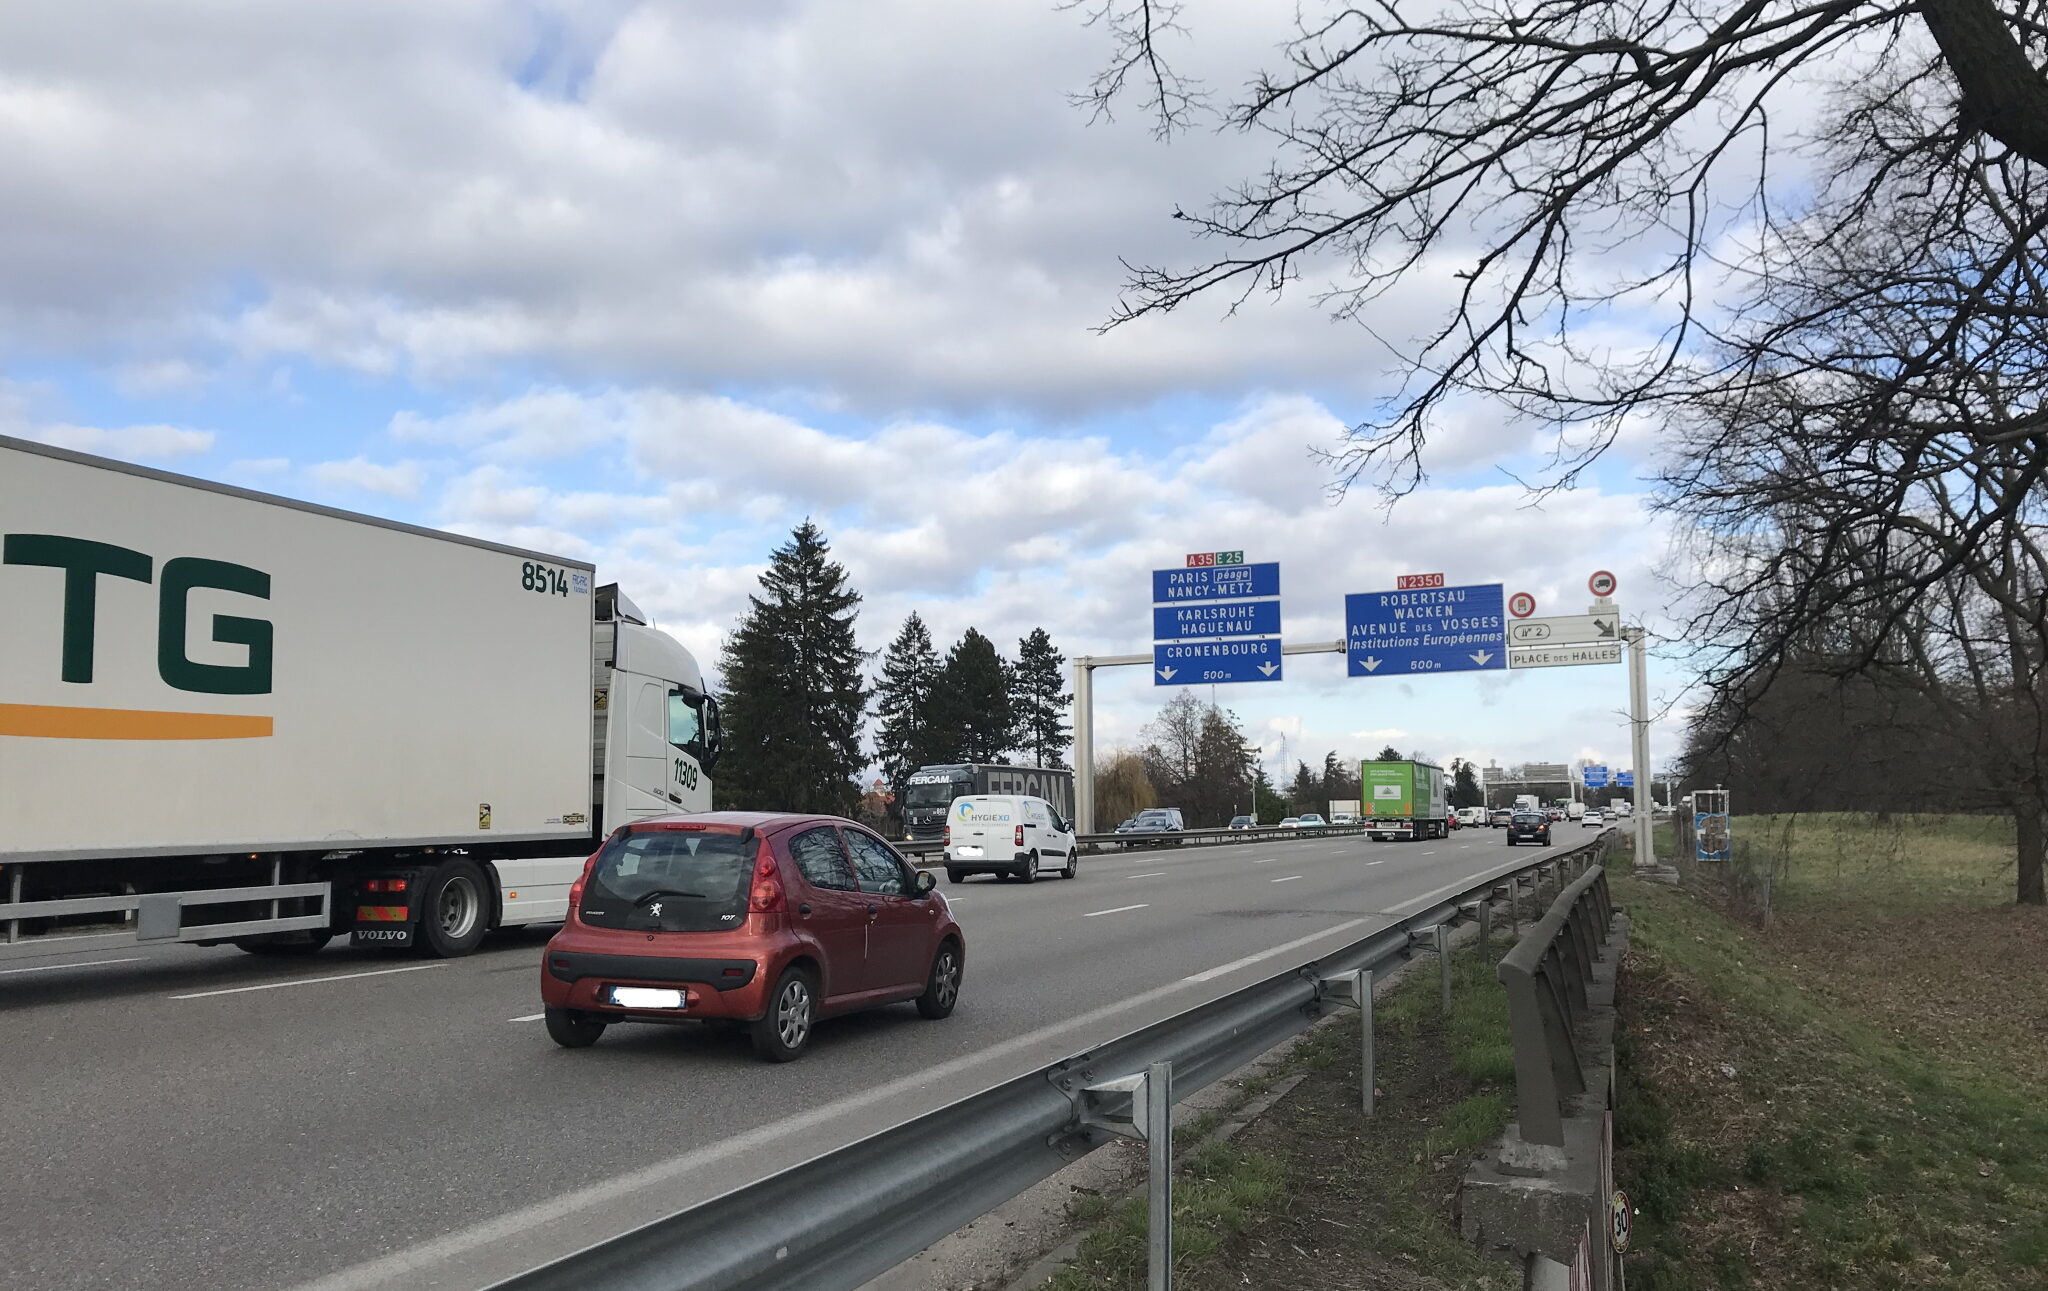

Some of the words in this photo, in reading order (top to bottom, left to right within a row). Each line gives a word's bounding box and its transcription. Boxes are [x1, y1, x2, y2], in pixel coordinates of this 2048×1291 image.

[522, 561, 568, 597] 8514
[1170, 571, 1208, 584] PARIS
[1216, 569, 1249, 581] péage
[1168, 583, 1253, 598] NANCY-METZ
[1380, 589, 1465, 606] ROBERTSAU
[1177, 606, 1255, 621] KARLSRUHE
[1394, 605, 1453, 619] WACKEN
[1181, 620, 1252, 635] HAGUENAU
[1351, 622, 1407, 636] AVENUE
[1415, 623, 1433, 632] DES
[1441, 616, 1499, 631] VOSGES
[1349, 636, 1419, 650] Institutions
[1423, 632, 1503, 647] Européennes
[1167, 643, 1268, 658] CRONENBOURG
[1514, 653, 1550, 664] PLACE
[1572, 650, 1616, 661] HALLES
[674, 757, 698, 792] 11309
[909, 775, 950, 785] FERCAM
[357, 930, 407, 941] VOLVO
[1615, 1208, 1627, 1237] 30
